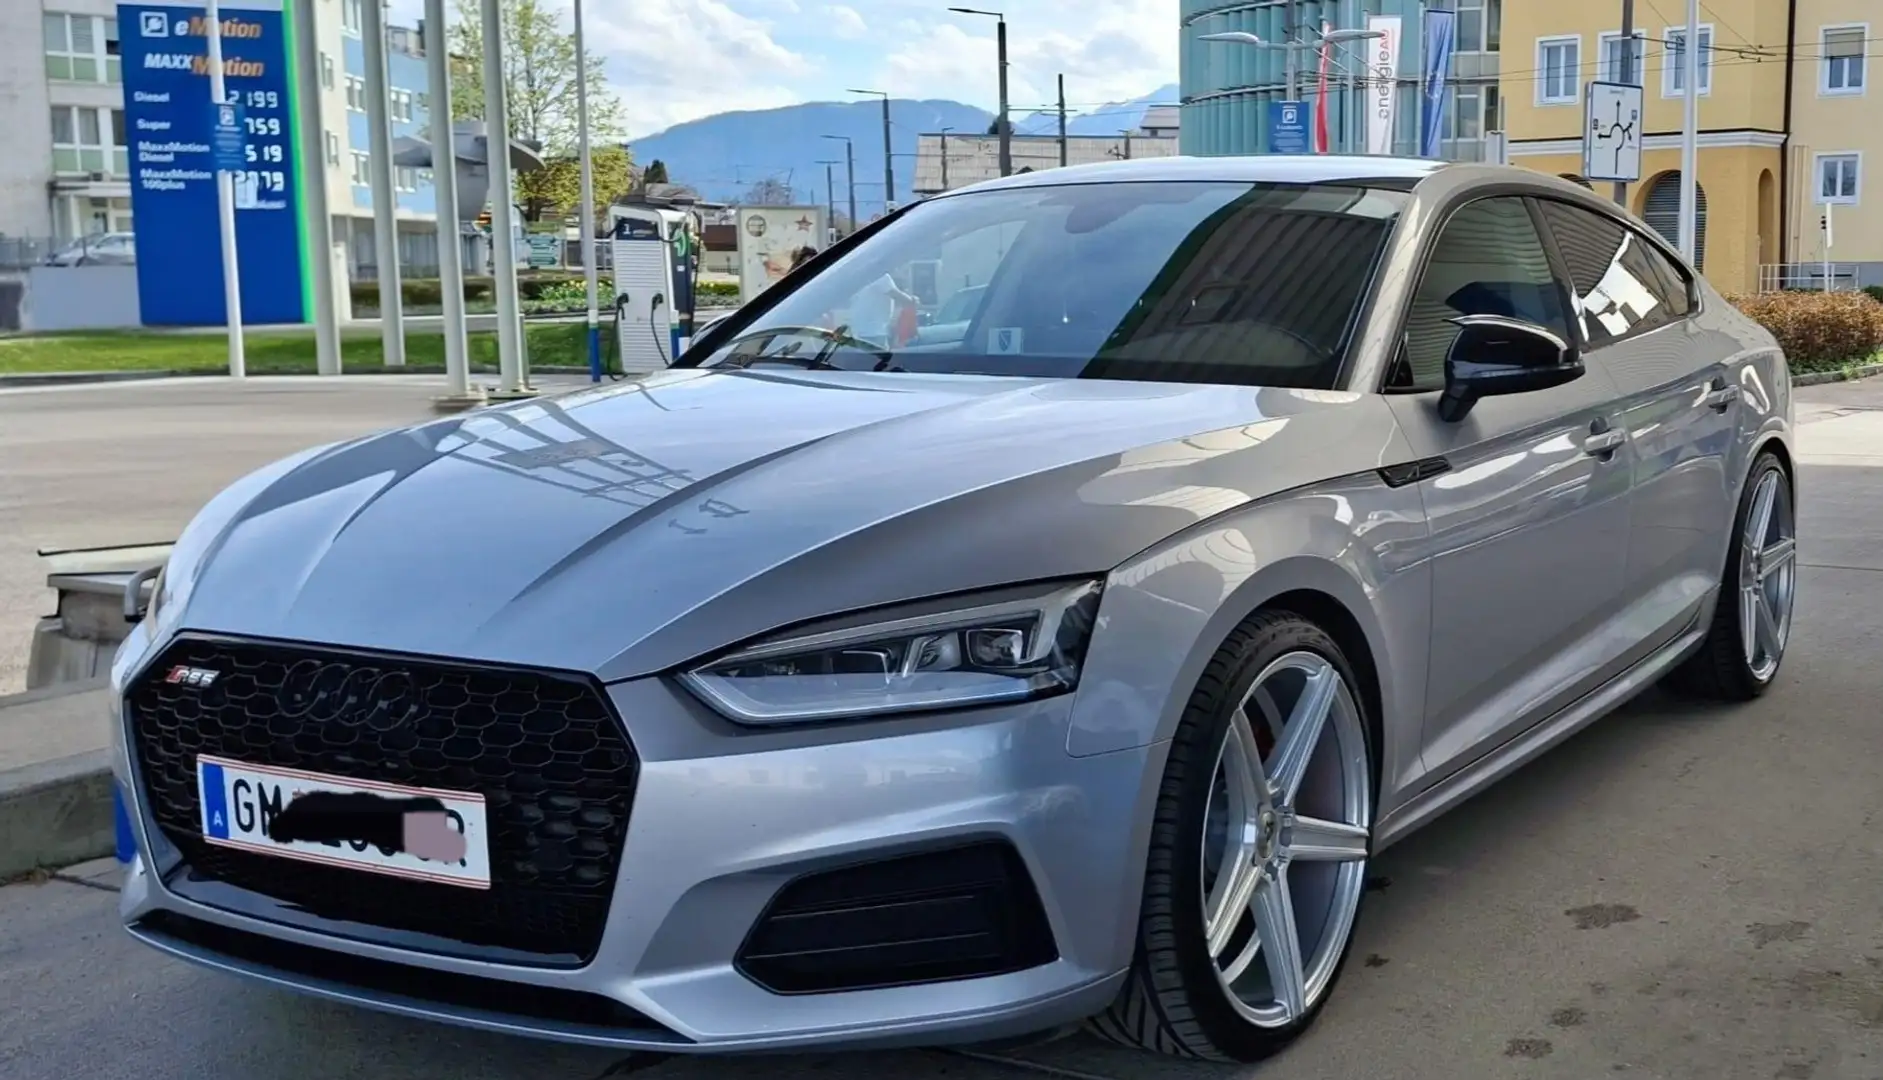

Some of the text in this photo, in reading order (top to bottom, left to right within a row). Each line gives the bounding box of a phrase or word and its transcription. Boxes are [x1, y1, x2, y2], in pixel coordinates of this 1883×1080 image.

[174, 16, 262, 38] eMtion
[144, 53, 265, 77] MAXXMtion
[134, 91, 170, 102] Diesel
[136, 118, 171, 131] Super
[138, 152, 174, 162] Diesel
[213, 812, 223, 827] A
